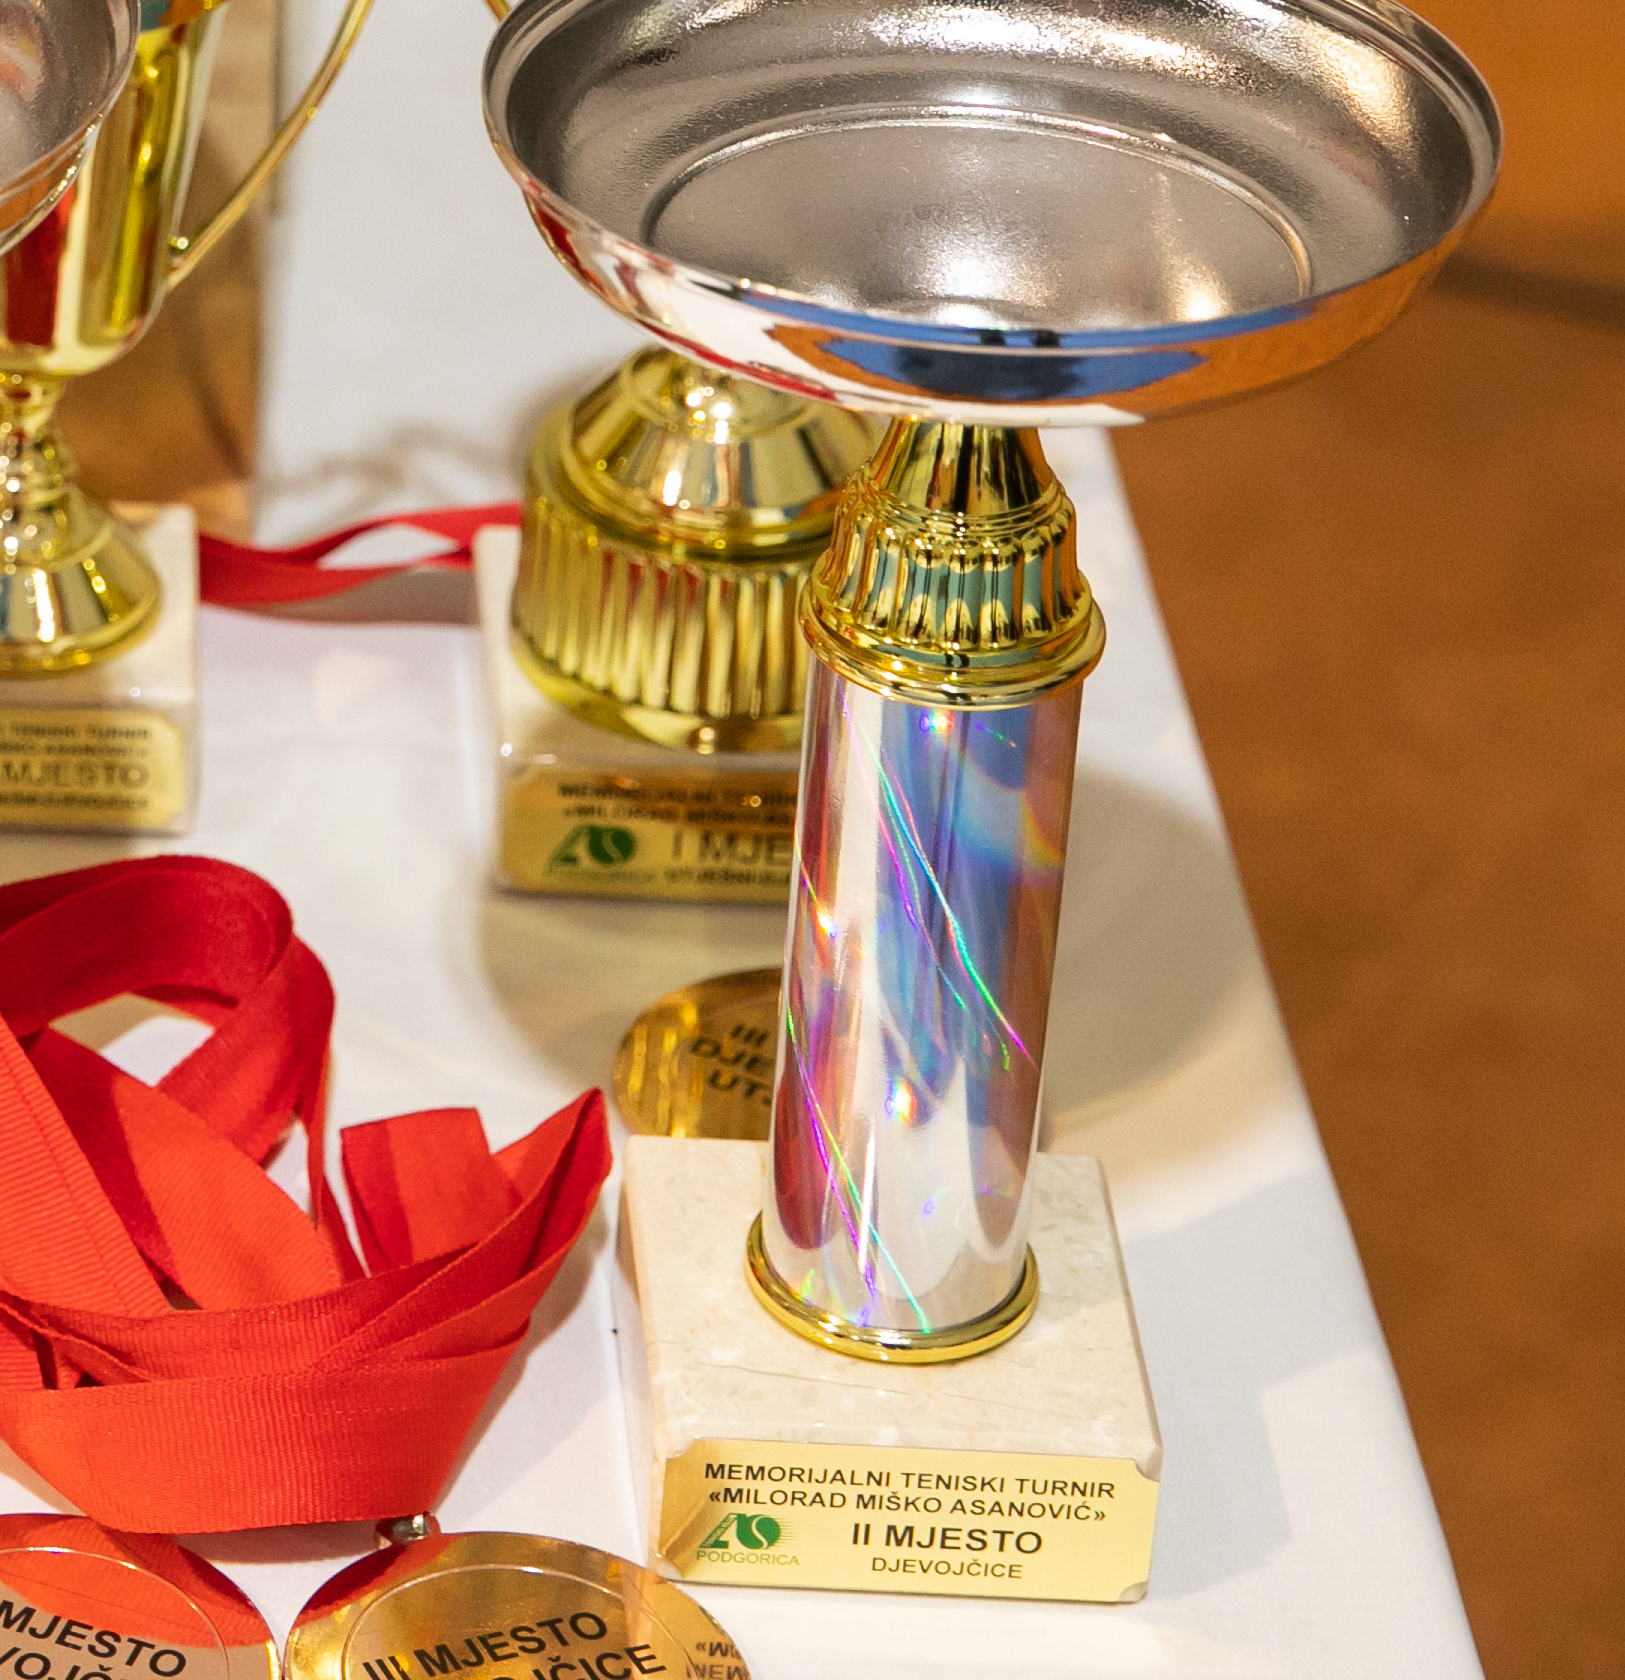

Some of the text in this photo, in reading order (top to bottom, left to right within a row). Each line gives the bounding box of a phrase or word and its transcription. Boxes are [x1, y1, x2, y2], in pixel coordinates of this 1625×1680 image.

[704, 1462, 1115, 1499] MEMORIJALNI TENISKI TURNIR
[708, 1486, 1106, 1523] «MILORAD MIŠKO ASANOVIĆ»
[852, 1522, 1044, 1555] II MJESTO
[695, 1549, 800, 1568] PODGORICA
[871, 1555, 1024, 1580] DJEVOJČICE
[362, 1612, 608, 1680] III MJESTO
